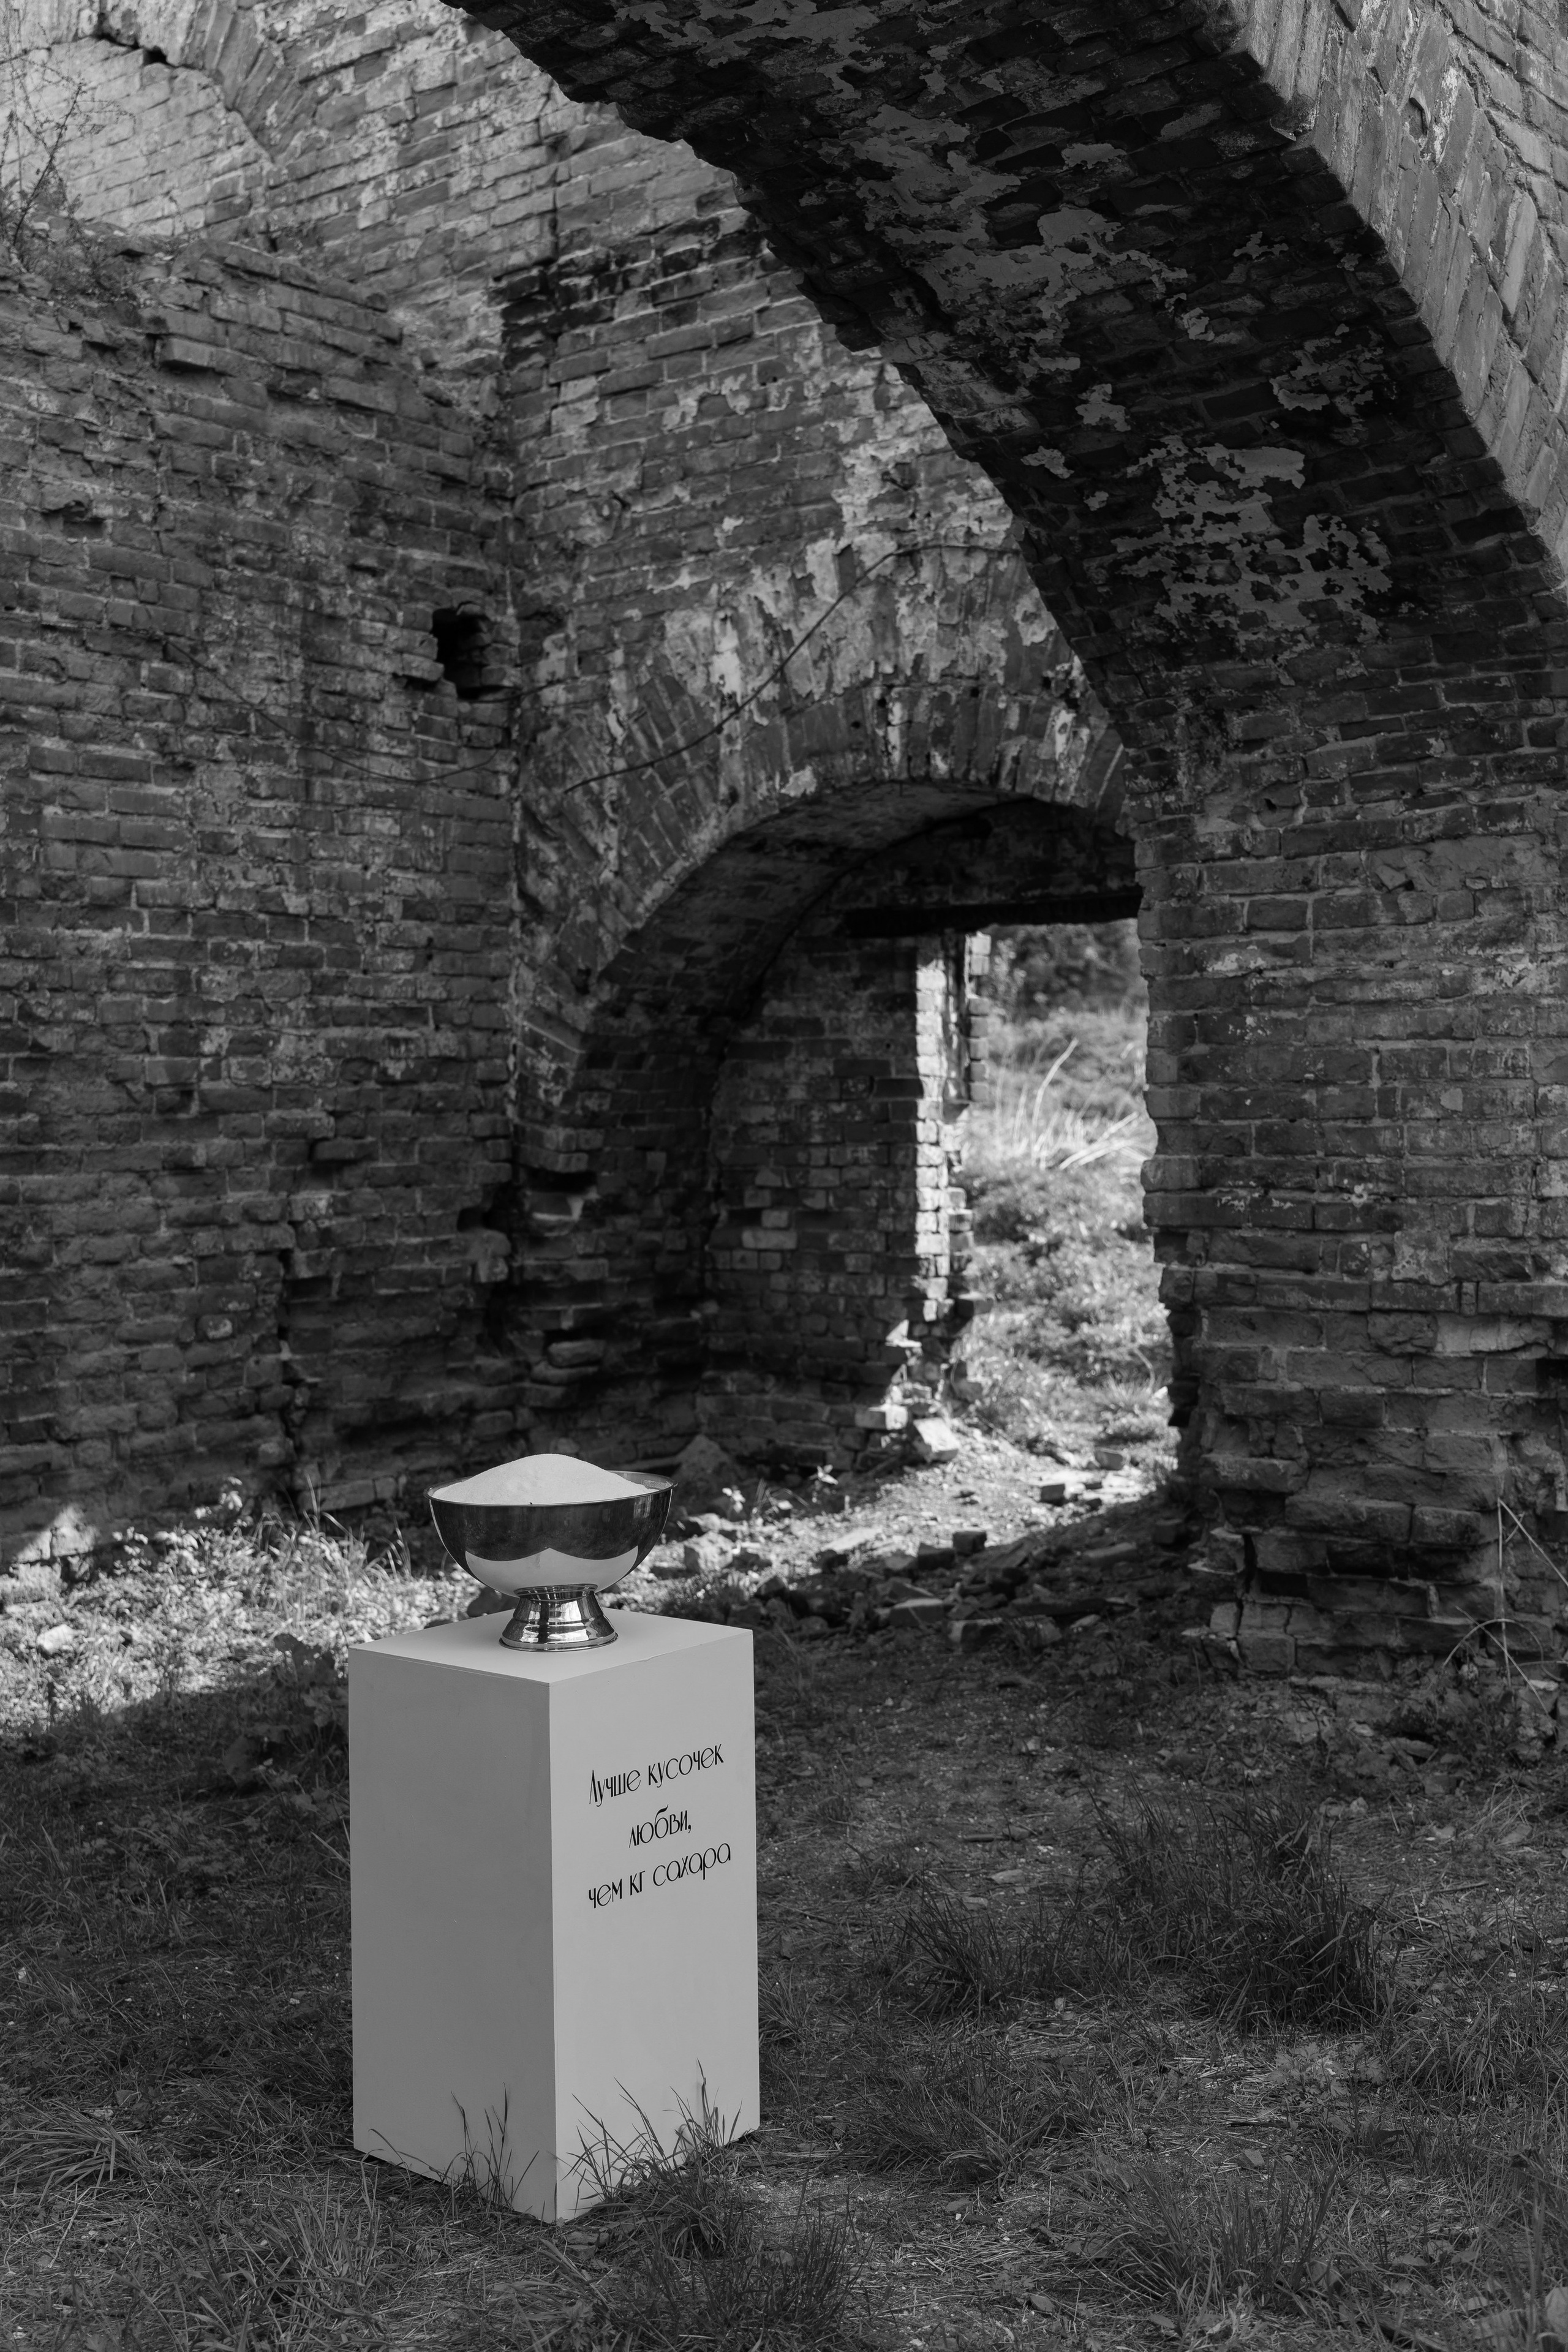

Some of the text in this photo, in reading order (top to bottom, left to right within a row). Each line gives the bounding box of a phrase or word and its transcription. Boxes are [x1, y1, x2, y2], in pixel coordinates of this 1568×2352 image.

[589, 1743, 724, 1807] Лучше кусочек
[628, 1804, 692, 1848] любви,
[588, 1842, 731, 1909] чем кг сахара
